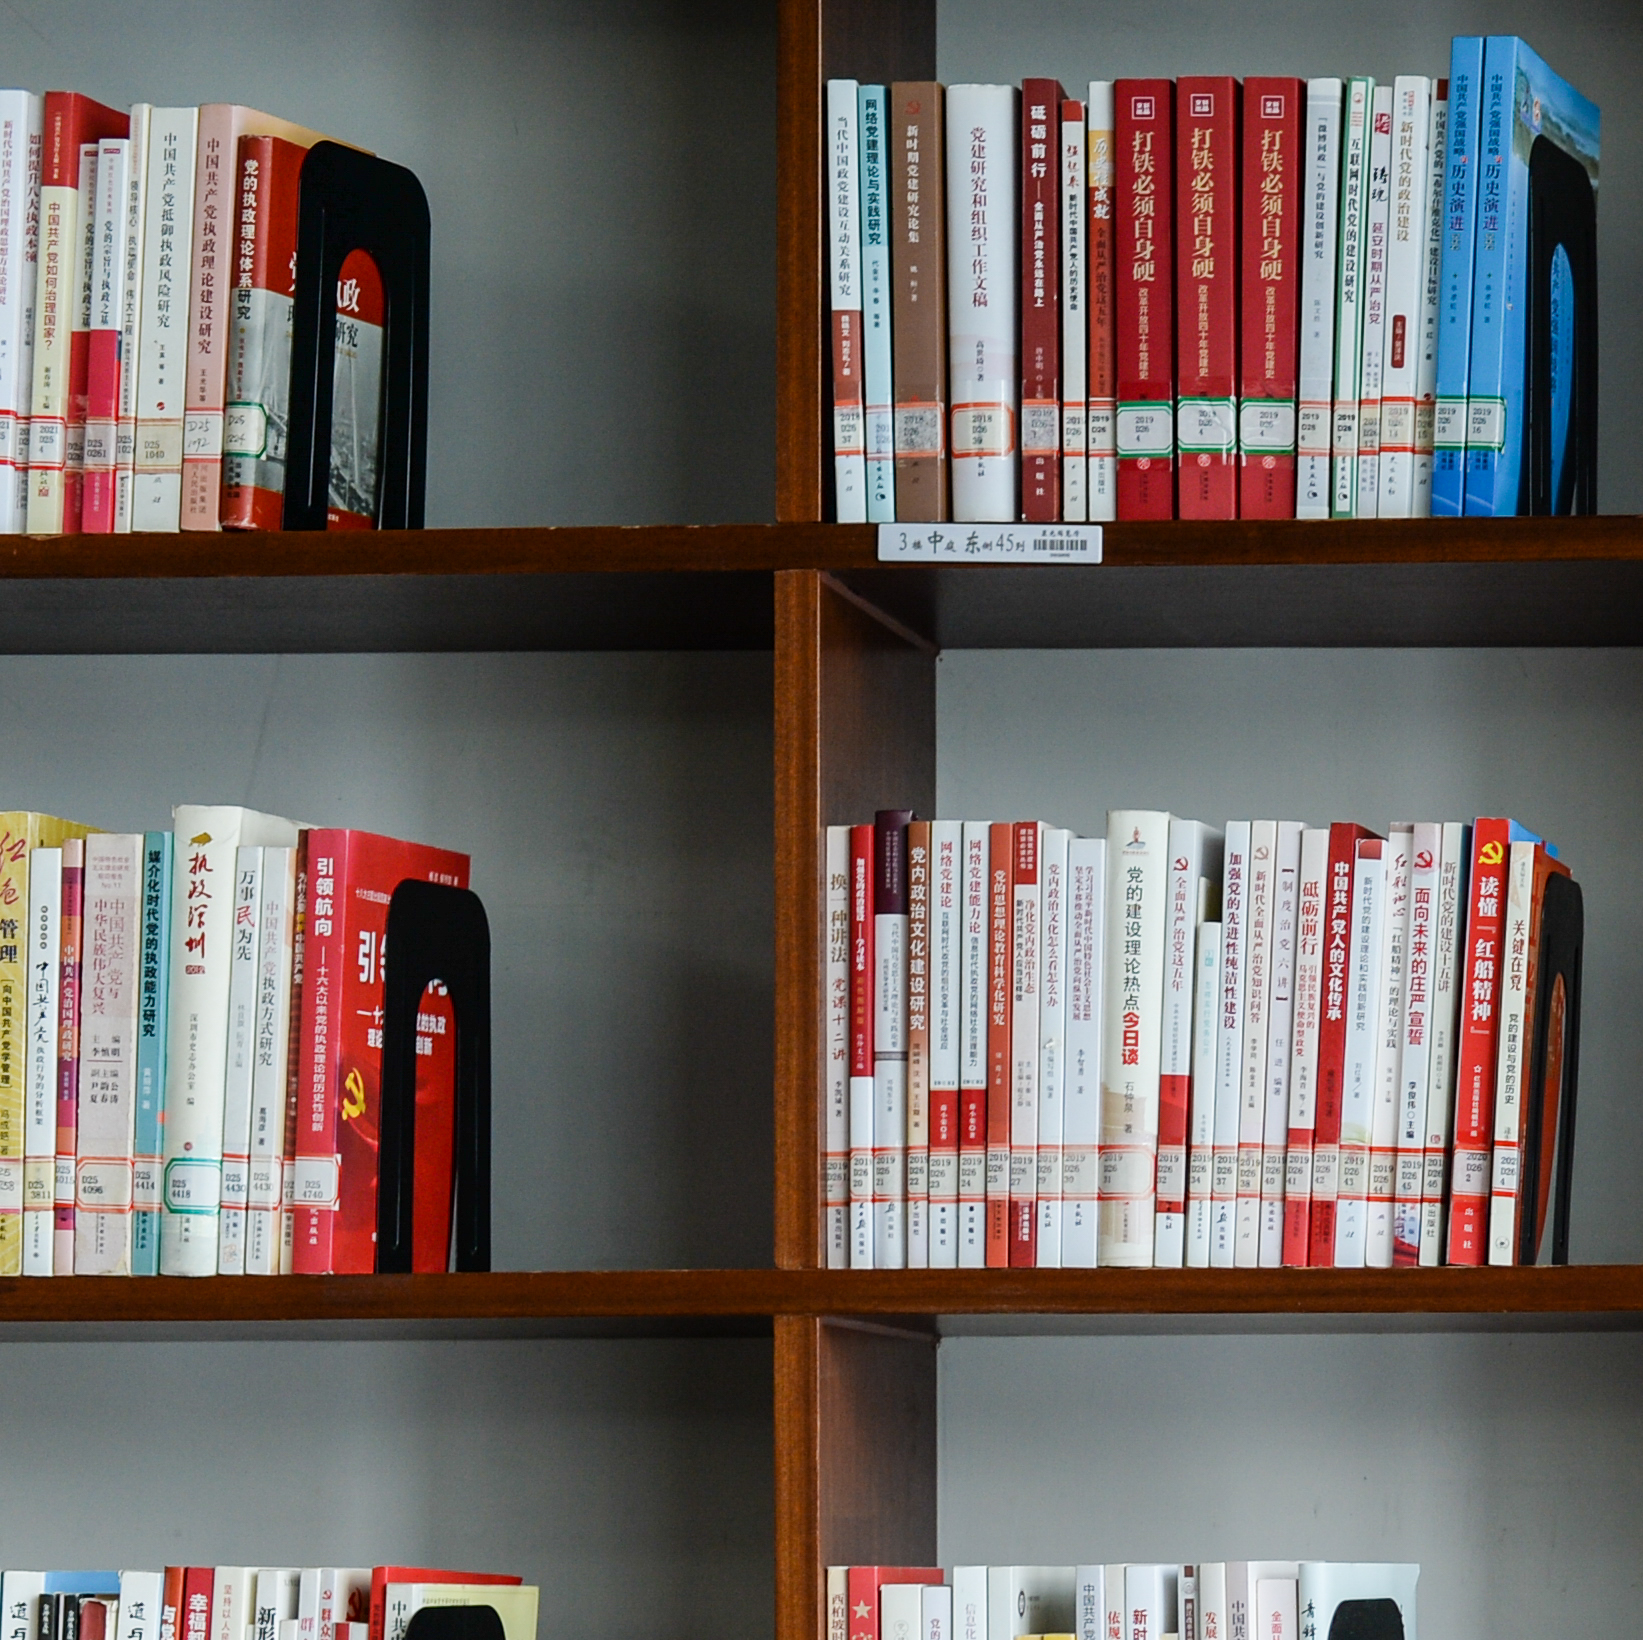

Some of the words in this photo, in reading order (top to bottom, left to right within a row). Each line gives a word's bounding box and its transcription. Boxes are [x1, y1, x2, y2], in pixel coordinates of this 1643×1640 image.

[970, 127, 988, 308] 党建研究和组织工作文稿
[1131, 130, 1156, 282] 打铁必须自身硬
[1190, 127, 1215, 279] 打铁必须自身硬
[1260, 129, 1283, 281] 打铁必须自身硬
[910, 847, 925, 1030] 党内政治文化建设研究
[1121, 866, 1143, 1066] 党的建设理论热点今日谈
